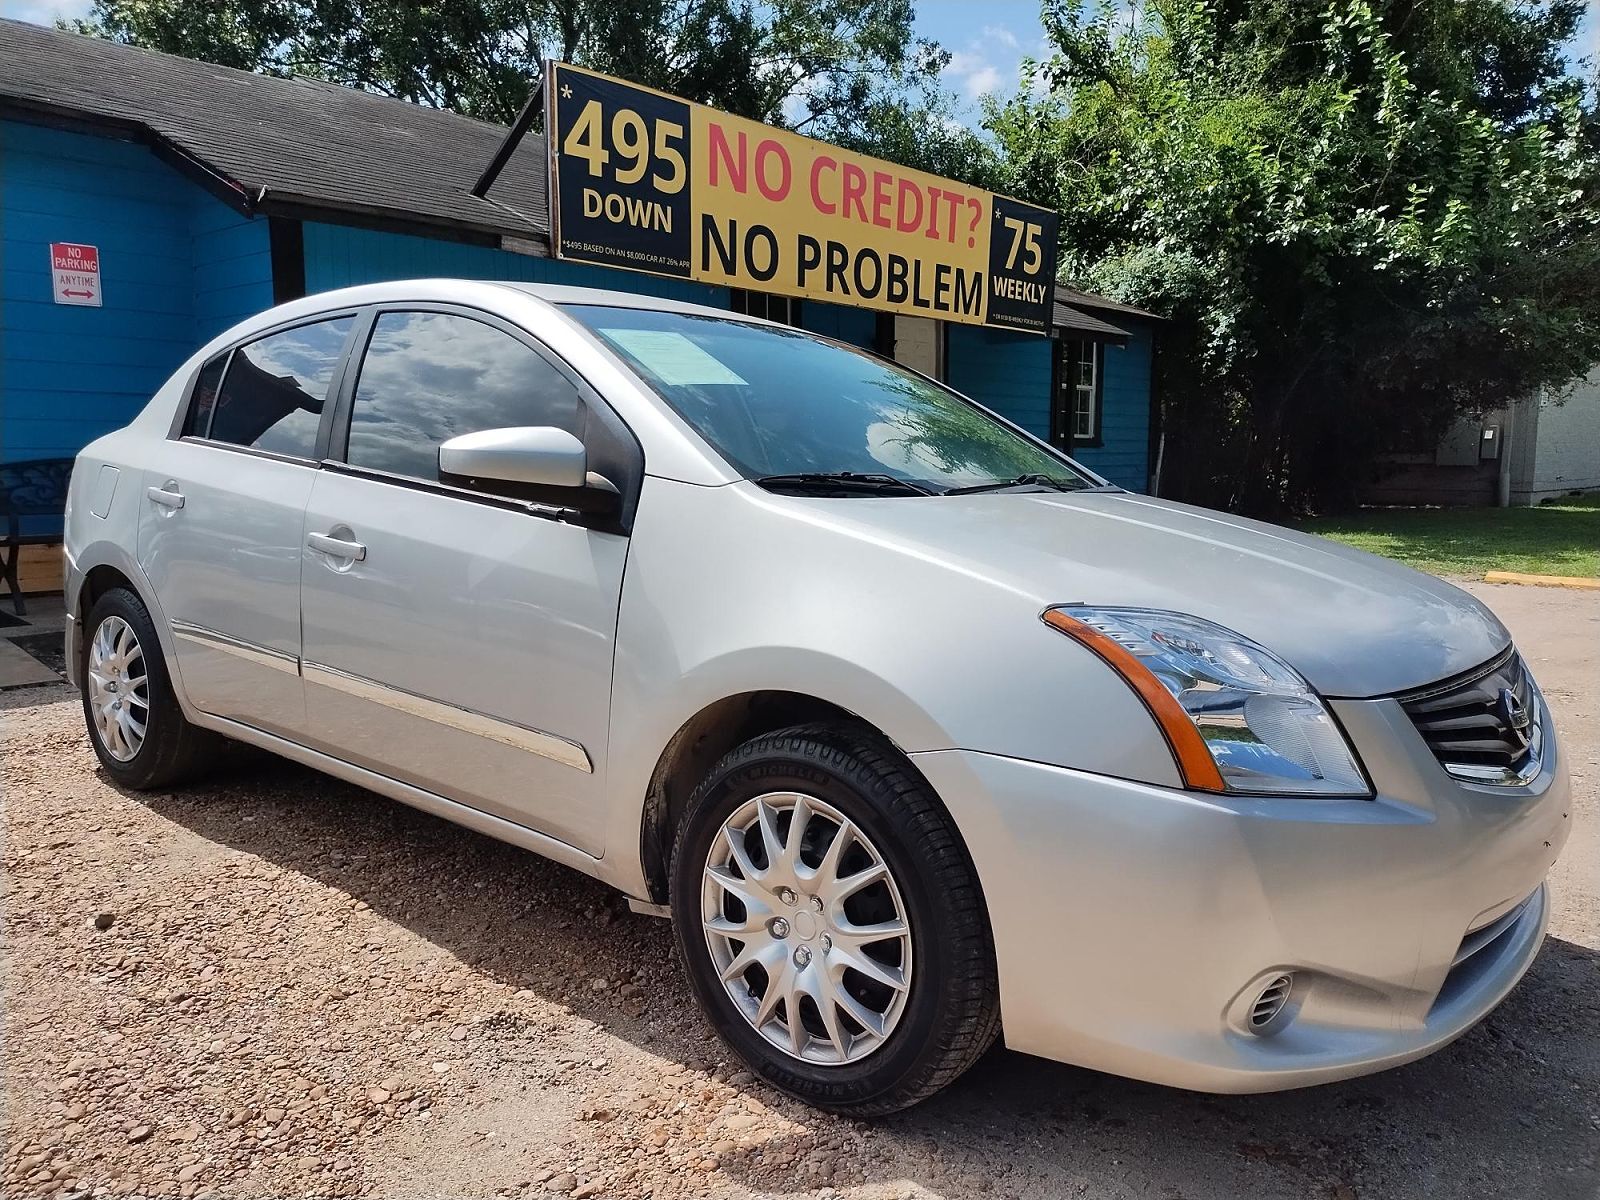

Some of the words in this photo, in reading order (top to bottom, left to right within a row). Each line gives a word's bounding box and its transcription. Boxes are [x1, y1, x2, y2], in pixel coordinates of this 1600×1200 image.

[709, 123, 791, 202] NO
[810, 156, 982, 248] CREDIT?
[583, 188, 672, 233] DOWN
[55, 257, 97, 271] PARKING
[67, 247, 81, 258] NO
[583, 243, 604, 254] BASED
[604, 247, 616, 255] ON
[616, 249, 626, 257] AN
[646, 254, 658, 263] CAR
[658, 256, 666, 264] AT
[701, 213, 779, 281] NO
[797, 234, 982, 316] PROBLEM
[60, 275, 94, 287] ANYTIME
[993, 275, 1047, 304] WEEKLY
